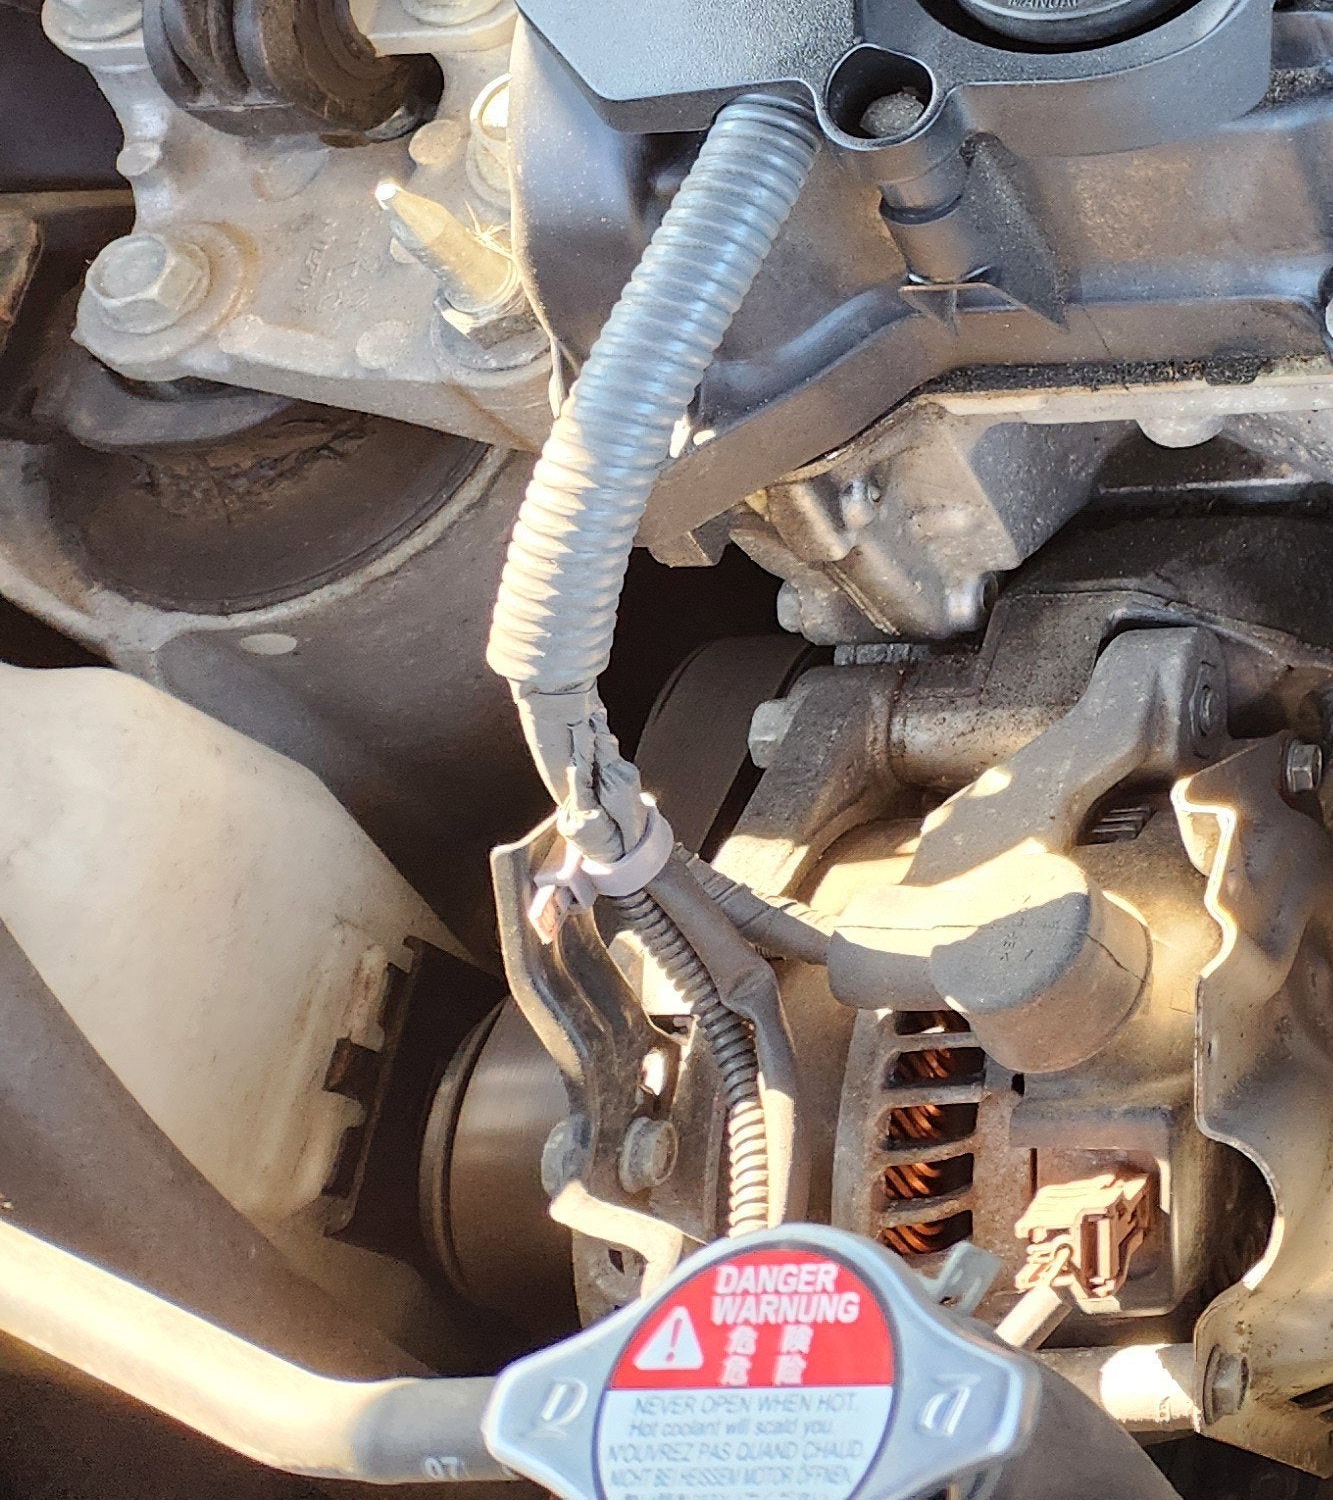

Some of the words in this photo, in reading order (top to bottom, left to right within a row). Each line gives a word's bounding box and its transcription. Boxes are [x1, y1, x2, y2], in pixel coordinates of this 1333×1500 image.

[715, 1263, 838, 1295] DANGER
[711, 1292, 860, 1325] WARNUNG
[635, 1396, 695, 1415] NEVER
[701, 1395, 751, 1414] OPEN
[758, 1393, 811, 1412] WHEN
[699, 1442, 732, 1461] PAS
